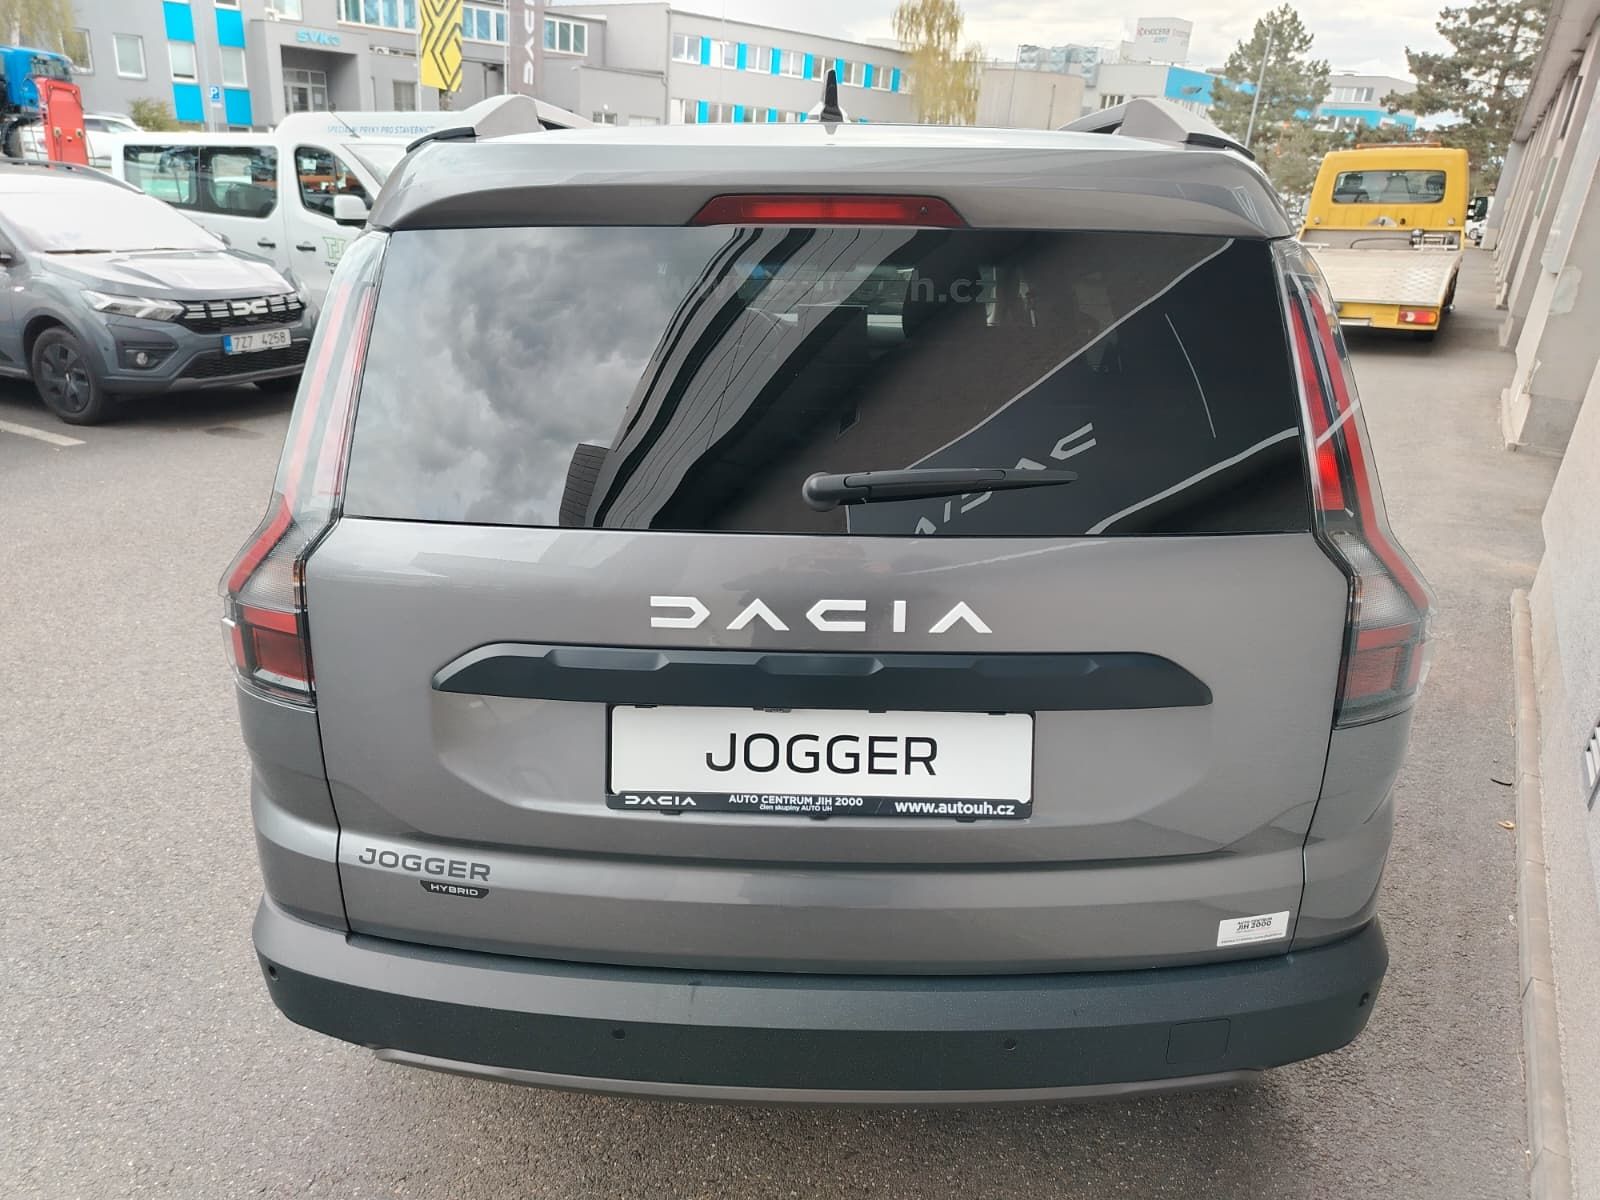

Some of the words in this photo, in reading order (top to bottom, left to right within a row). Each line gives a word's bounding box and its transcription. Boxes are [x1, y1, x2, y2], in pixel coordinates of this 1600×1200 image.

[650, 595, 993, 634] DACIA
[705, 732, 938, 776] JOGGER
[624, 795, 697, 806] DACIA
[728, 794, 759, 804] AUTO
[761, 795, 813, 805] CENTRUM
[815, 796, 833, 806] JIH
[834, 797, 864, 807] 2000
[801, 804, 821, 812] AUTO
[894, 801, 1016, 816] www.autouh.cz
[358, 847, 491, 882] JOGGER
[430, 883, 479, 896] HYBRID
[1250, 920, 1272, 929] 2000
